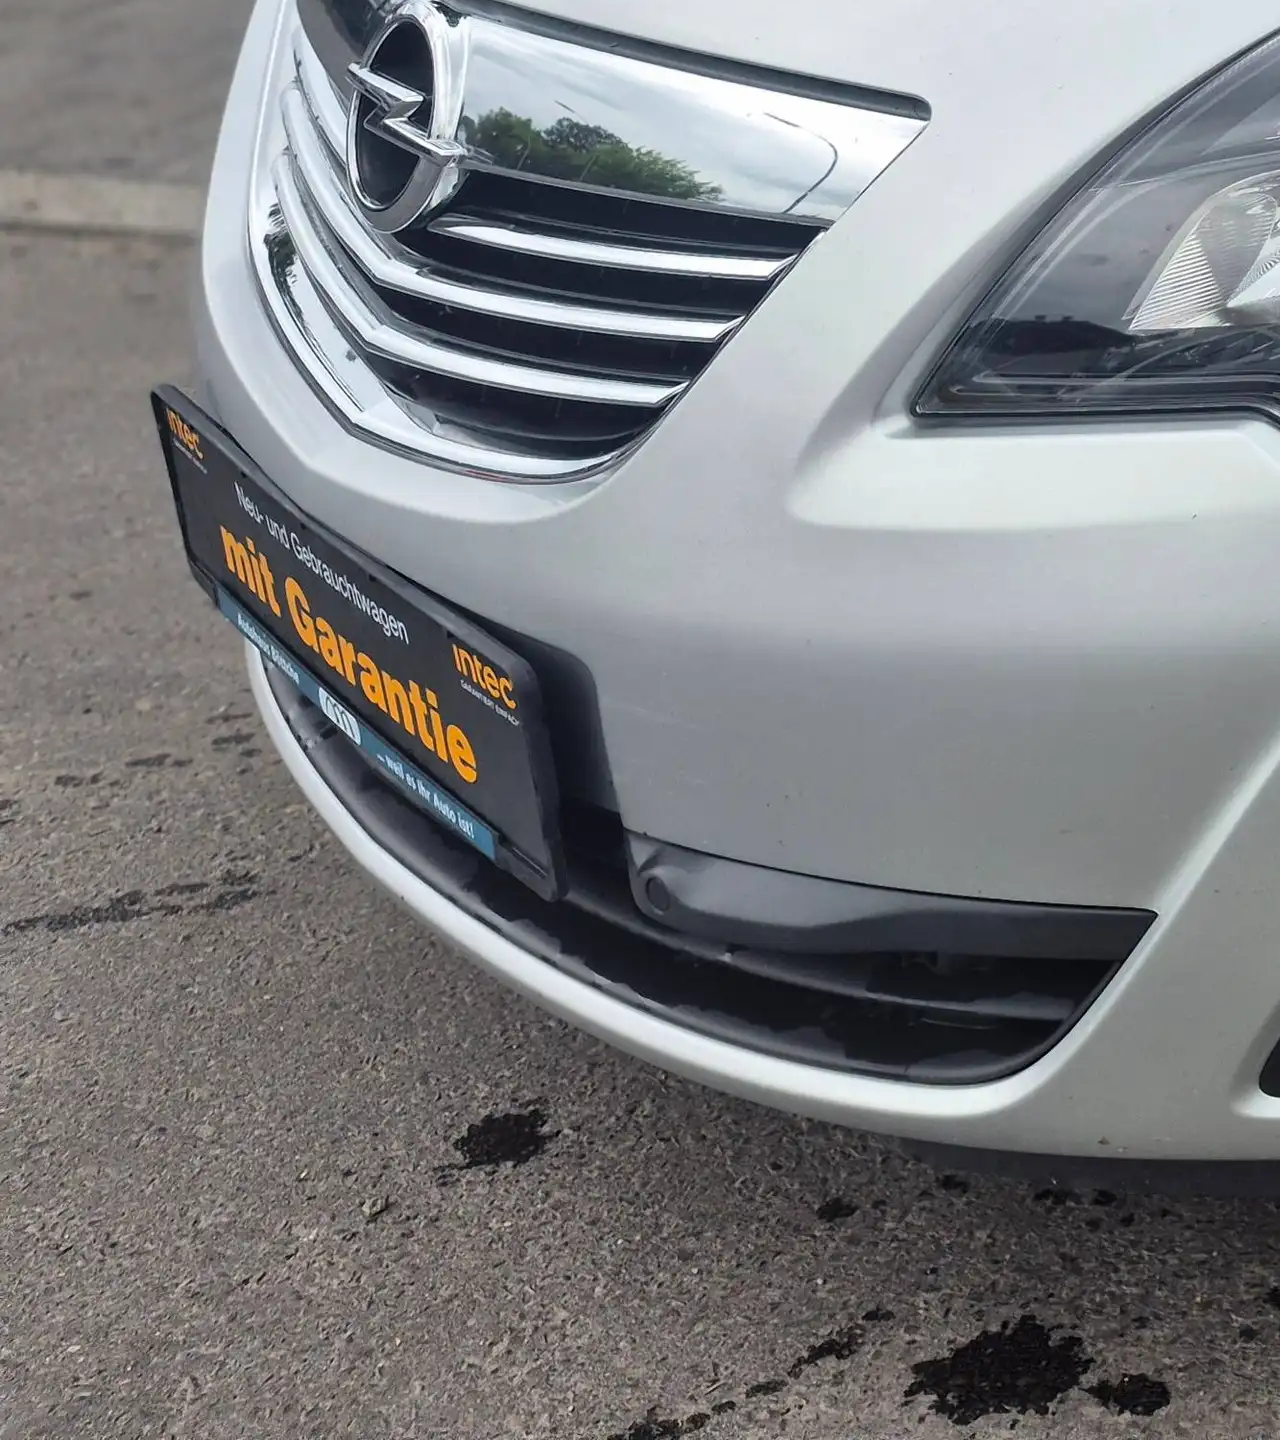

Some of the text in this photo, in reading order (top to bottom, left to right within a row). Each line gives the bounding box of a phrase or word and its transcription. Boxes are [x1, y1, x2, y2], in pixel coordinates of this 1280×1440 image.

[166, 408, 204, 459] intec
[234, 479, 410, 645] Neu- und Gebrauchtwagen
[219, 524, 478, 784] mit Garantie
[452, 643, 517, 710] intec
[433, 793, 457, 824] Auto
